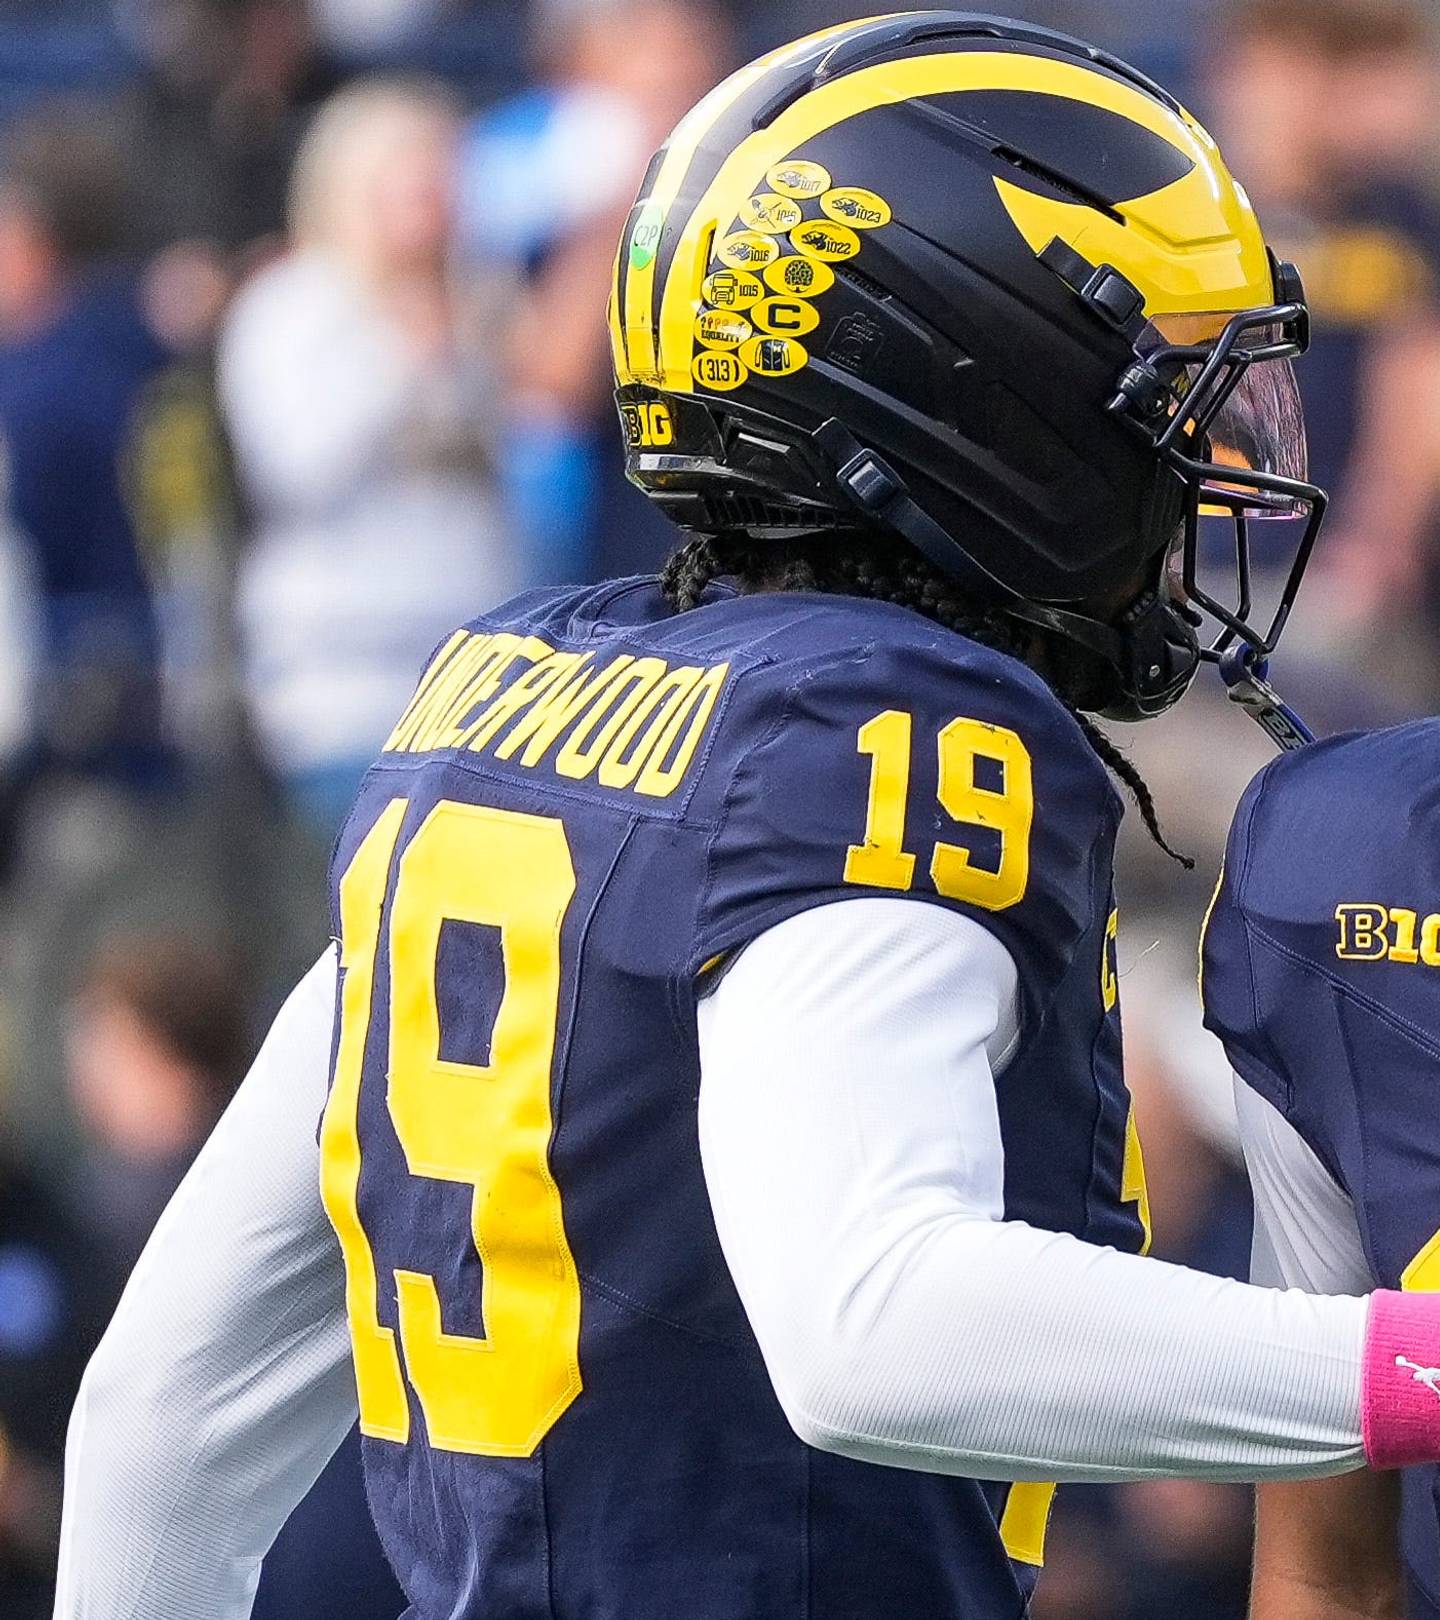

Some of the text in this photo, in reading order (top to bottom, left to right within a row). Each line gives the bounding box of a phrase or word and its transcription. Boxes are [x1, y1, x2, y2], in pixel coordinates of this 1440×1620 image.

[856, 207, 882, 223] 1023
[826, 238, 851, 255] 1022
[739, 284, 759, 297] 1015
[768, 303, 801, 330] C
[843, 709, 1034, 912] 19
[320, 796, 583, 1457] 19
